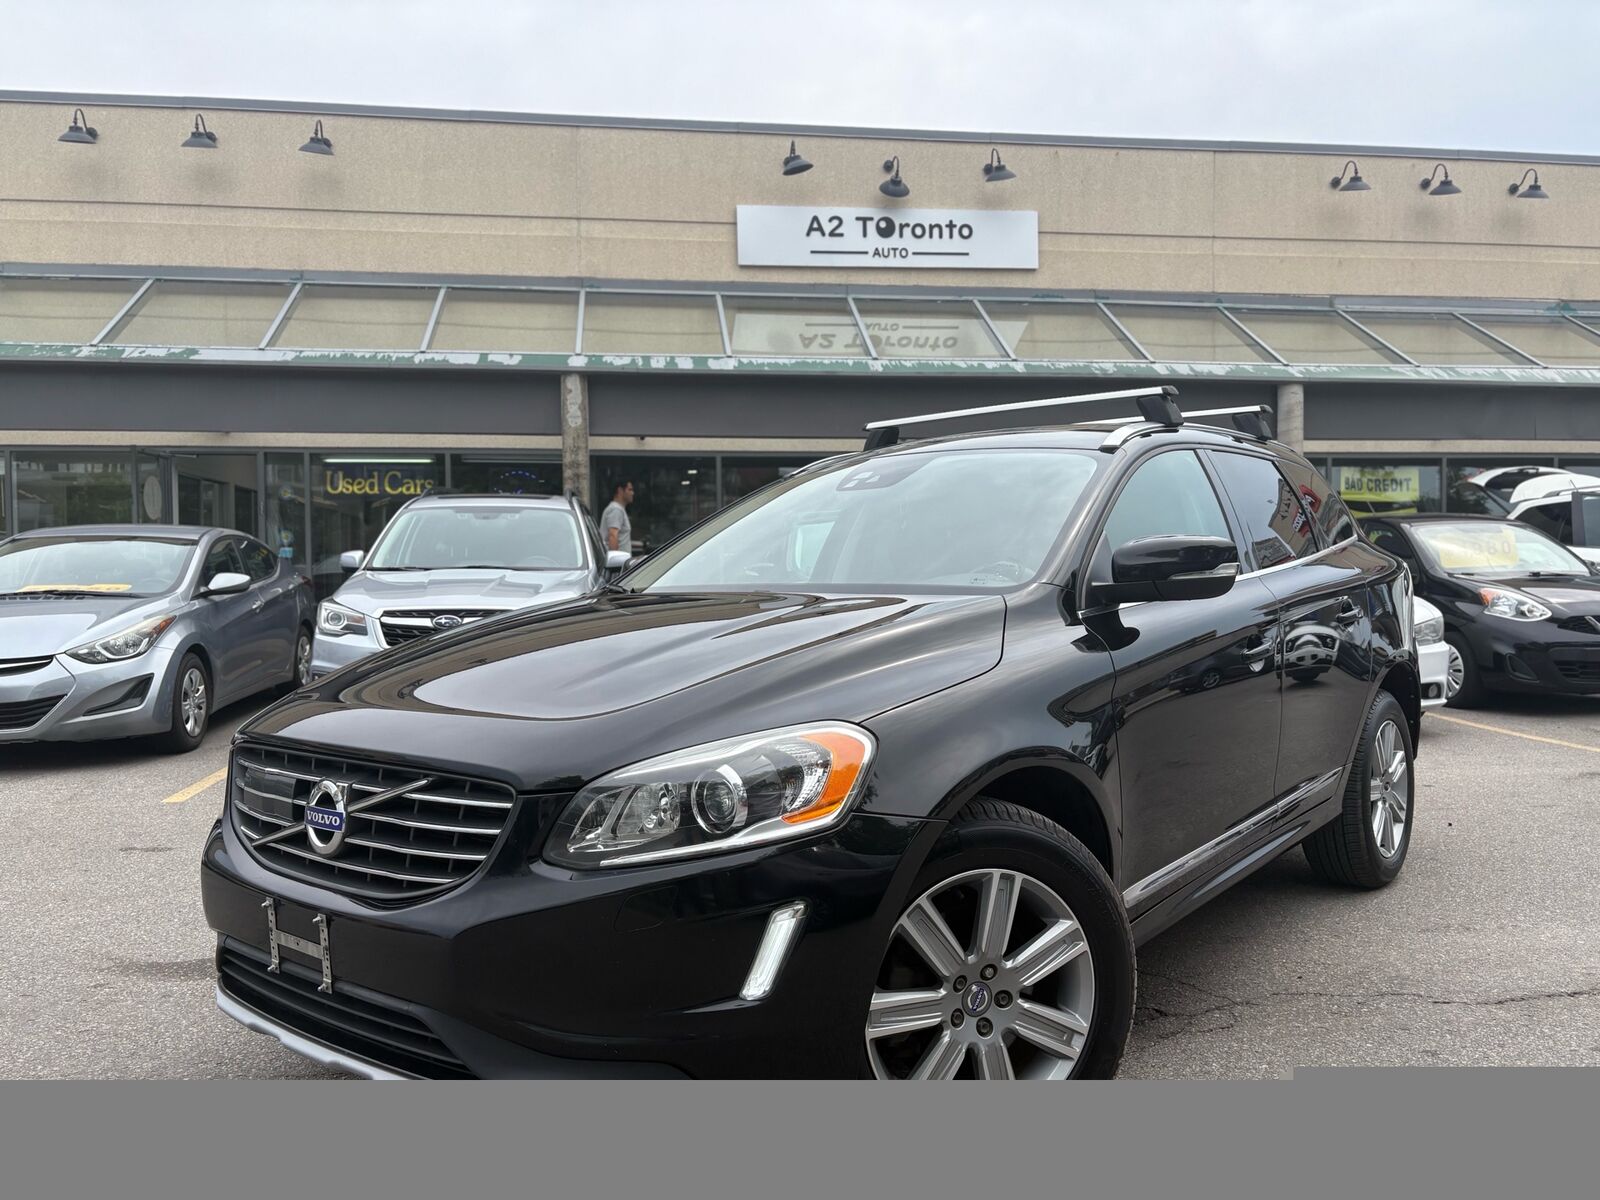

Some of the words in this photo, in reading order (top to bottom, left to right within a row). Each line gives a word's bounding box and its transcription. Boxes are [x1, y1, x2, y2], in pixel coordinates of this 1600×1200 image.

[806, 215, 844, 238] A2
[872, 247, 909, 259] AUTO
[326, 470, 379, 494] Used
[1344, 477, 1363, 491] BAD
[1366, 478, 1412, 492] CREDIT
[307, 810, 340, 826] VOLVO
